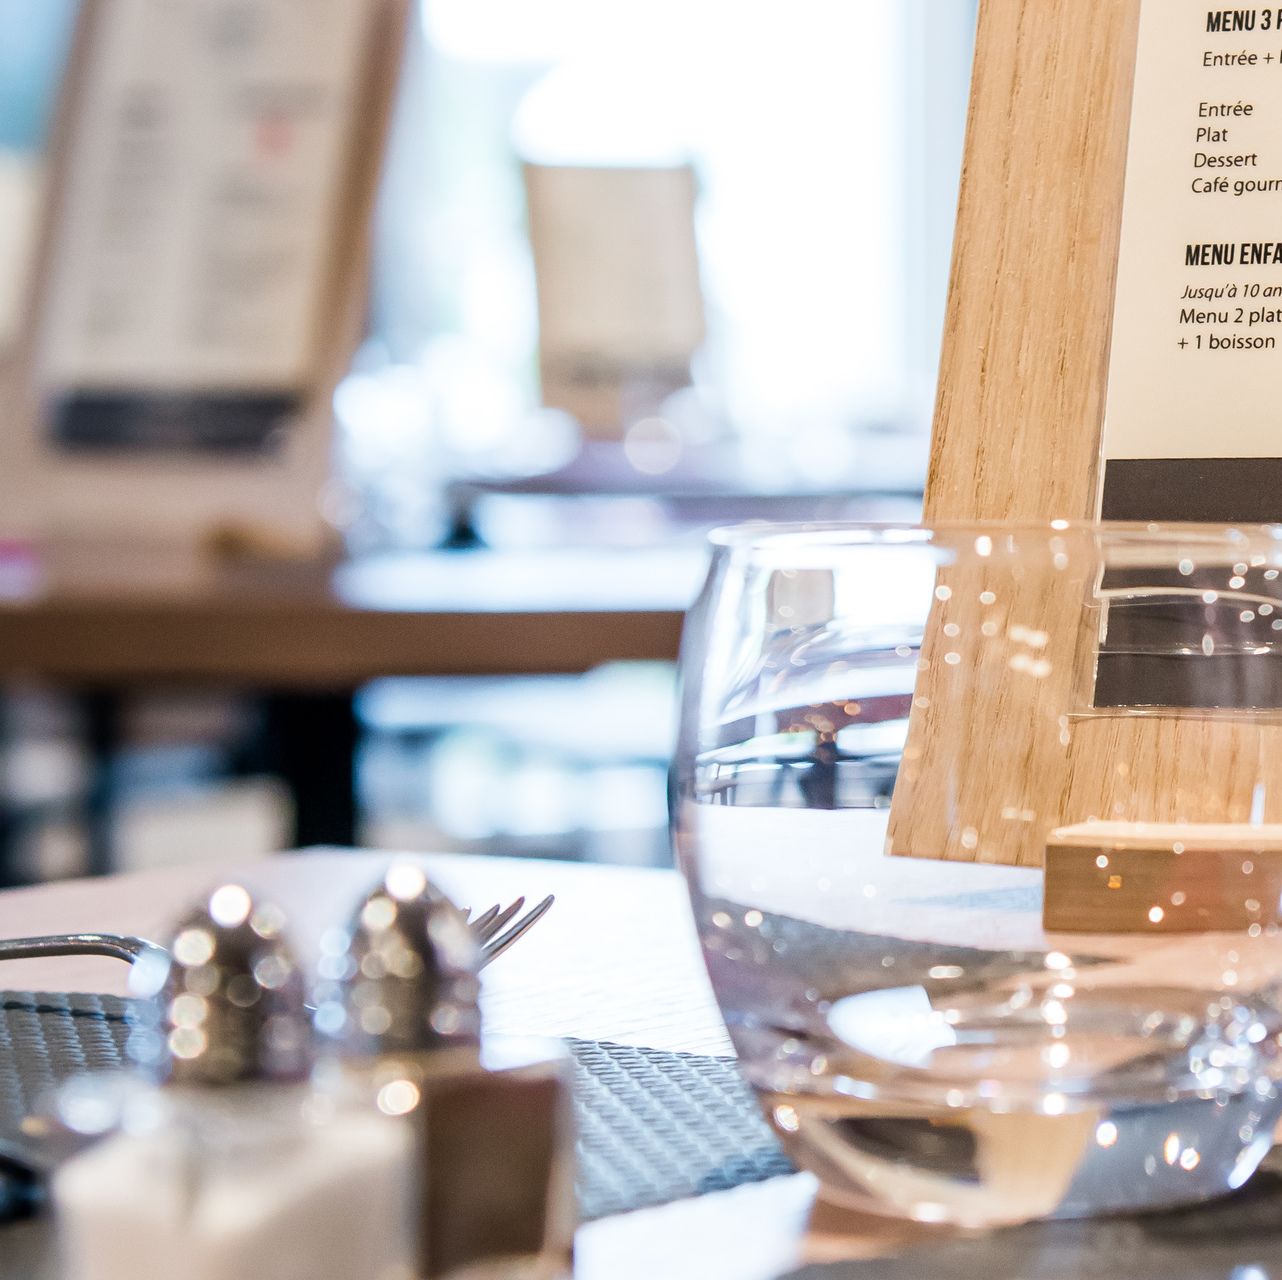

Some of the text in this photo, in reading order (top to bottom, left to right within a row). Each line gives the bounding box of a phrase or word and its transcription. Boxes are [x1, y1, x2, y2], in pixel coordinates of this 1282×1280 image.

[1206, 10, 1256, 32] MENU
[1260, 9, 1271, 30] 3
[1203, 50, 1258, 67] Entrée
[1198, 100, 1253, 117] Entrée
[1196, 127, 1228, 143] Plat
[1194, 153, 1258, 168] Dessert
[1191, 176, 1230, 193] Café
[1185, 243, 1235, 266] MENU
[1242, 284, 1260, 298] 10
[1179, 308, 1229, 324] Menu
[1234, 308, 1244, 323] 2
[1195, 335, 1202, 349] 1
[1209, 334, 1275, 350] boisson
